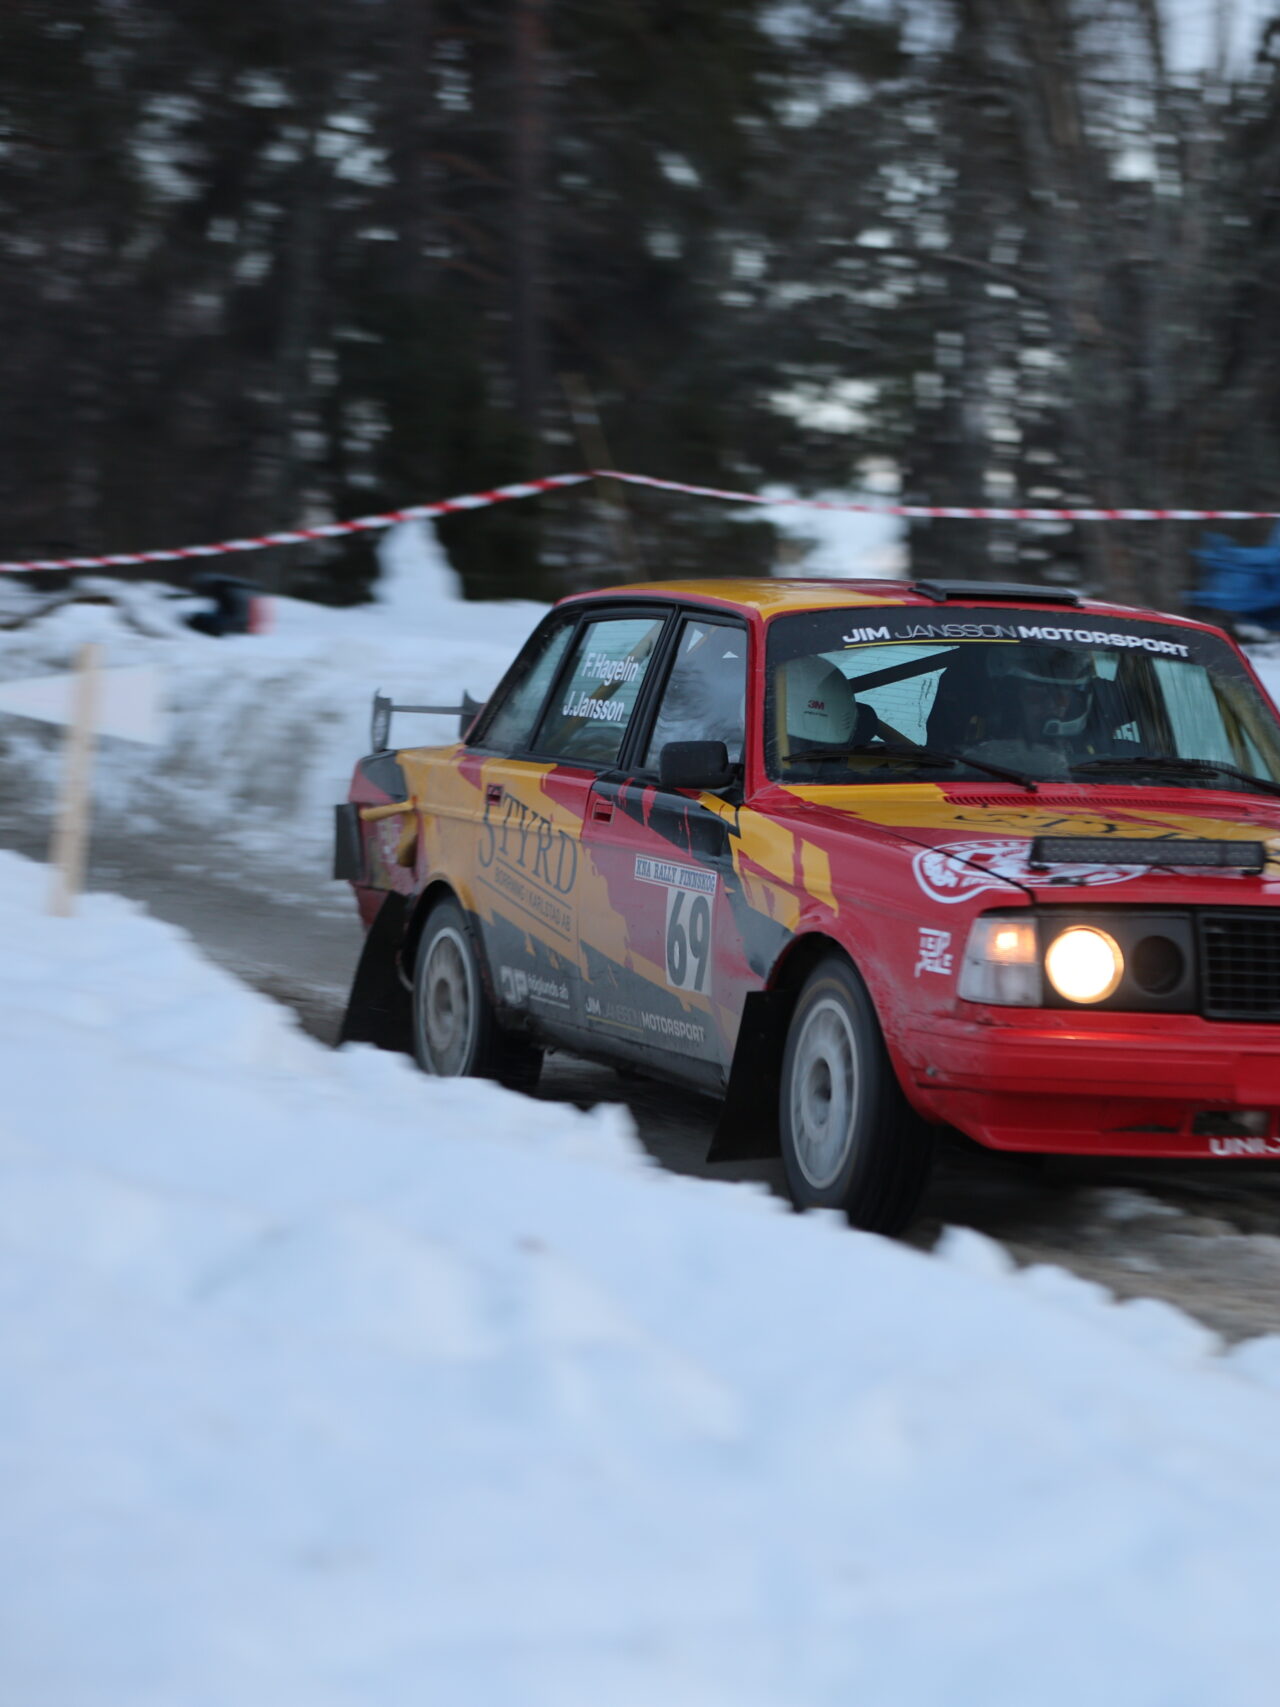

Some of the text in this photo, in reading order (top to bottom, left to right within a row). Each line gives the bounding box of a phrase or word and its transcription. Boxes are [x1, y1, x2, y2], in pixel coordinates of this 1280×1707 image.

[842, 624, 1189, 657] JIM JANSSON MOTORSPORT
[582, 652, 639, 686] F.Hagelin
[562, 691, 625, 721] J.Jansson
[807, 699, 825, 711] 3M
[478, 785, 577, 895] STYRD
[636, 859, 716, 893] KNA RALLY FINNSKOG
[667, 890, 711, 992] 69
[641, 1011, 705, 1043] MOTORSPORT
